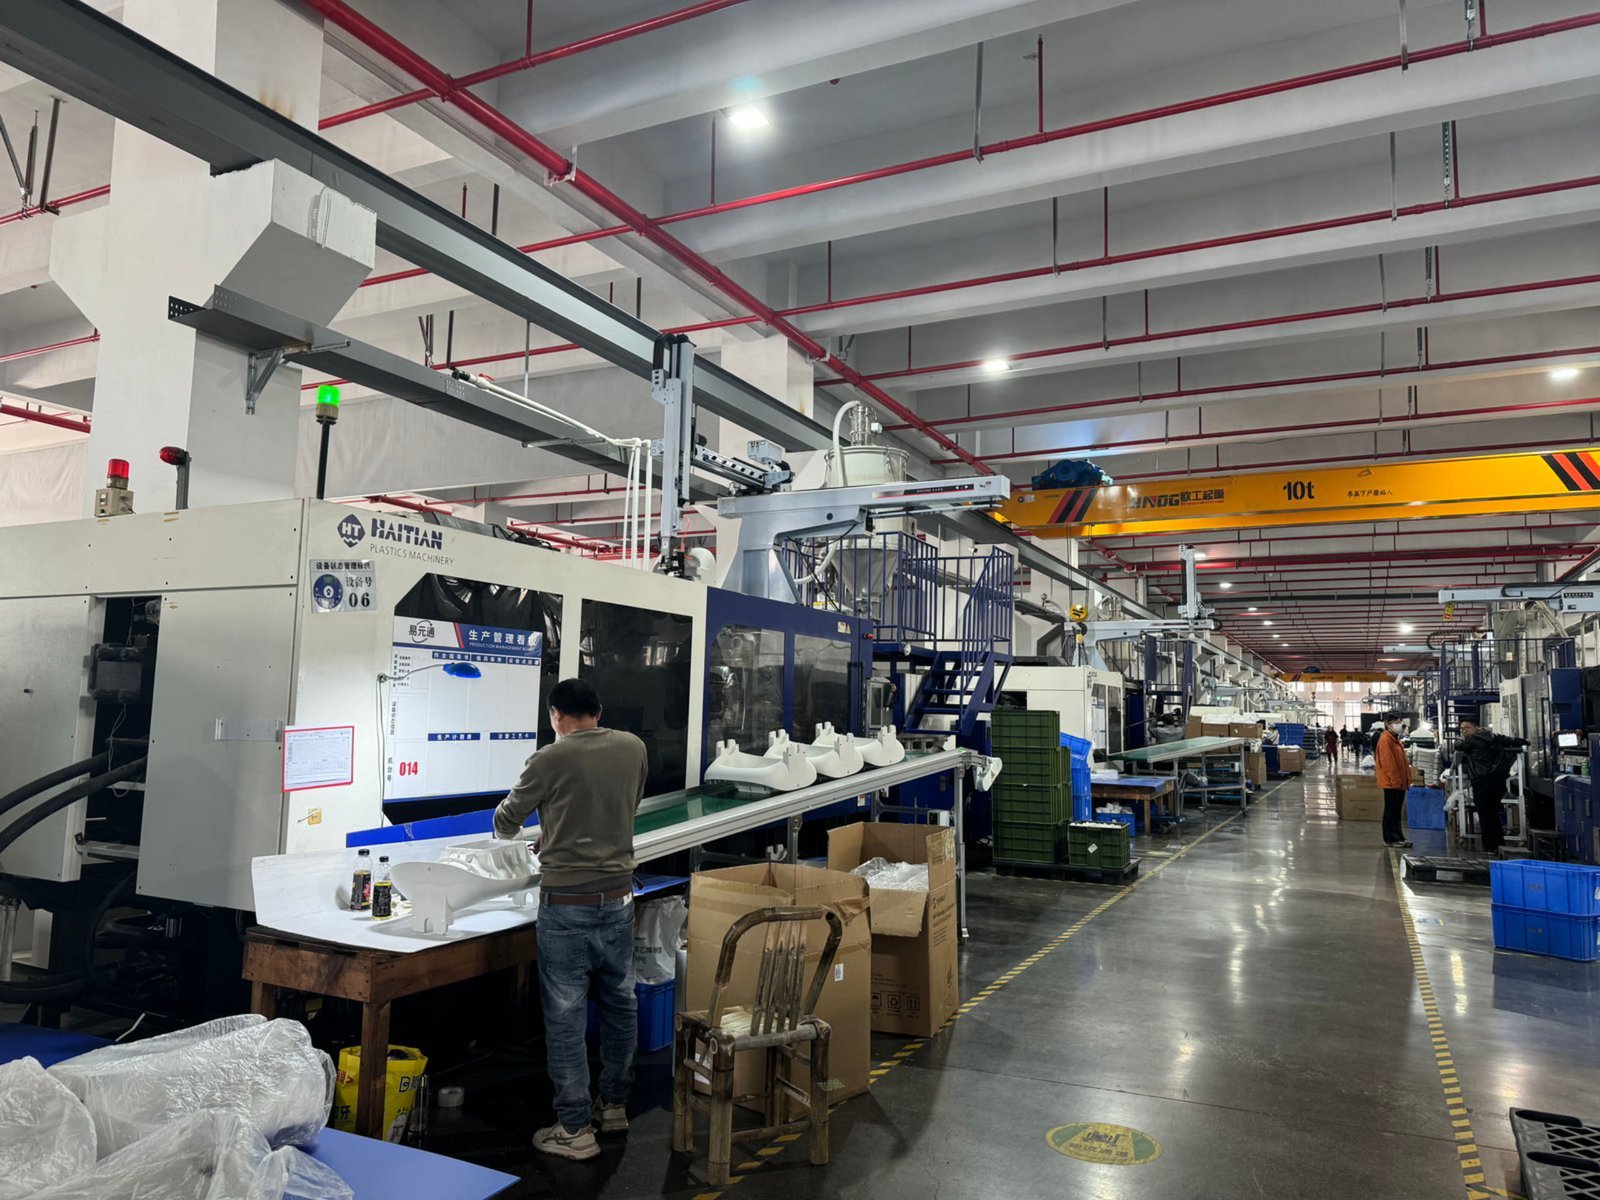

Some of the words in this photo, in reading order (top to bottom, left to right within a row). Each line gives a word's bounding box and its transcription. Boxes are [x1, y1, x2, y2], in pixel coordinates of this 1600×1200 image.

[1282, 480, 1315, 501] 10t
[341, 521, 362, 537] HT
[371, 517, 443, 550] HAITIAN
[369, 543, 407, 559] PLASTICS
[408, 550, 455, 567] MACHINERY
[316, 561, 371, 570] 设备状态管理标识
[345, 576, 372, 588] 设备号
[348, 592, 371, 608] 06
[408, 624, 435, 638] 易元通
[399, 761, 419, 776] 014
